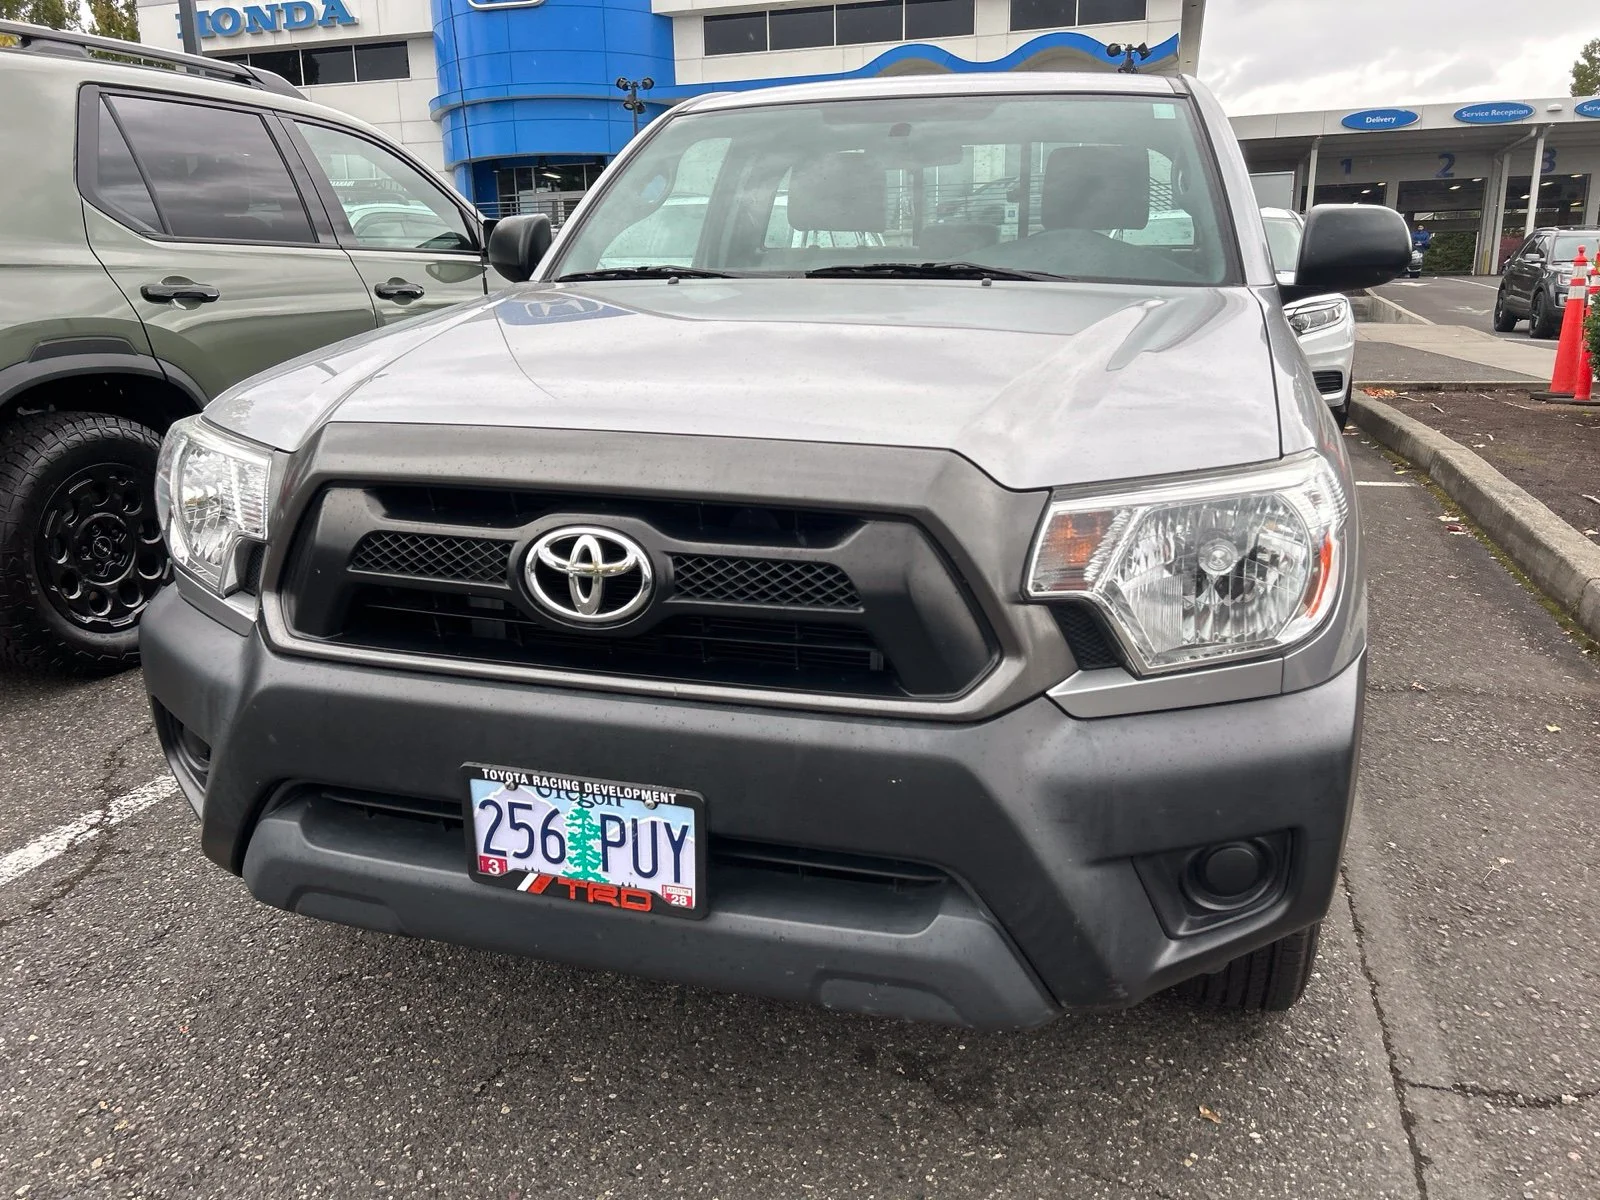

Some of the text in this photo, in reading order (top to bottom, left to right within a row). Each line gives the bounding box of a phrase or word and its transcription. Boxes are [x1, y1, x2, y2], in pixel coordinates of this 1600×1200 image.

[1365, 115, 1397, 125] Delivery
[1461, 107, 1529, 118] Service Reception
[1340, 158, 1353, 175] 1
[1435, 153, 1456, 178] 2
[481, 768, 677, 805] TOYOTA RACING DEVELOPMENT
[478, 798, 690, 884] 256 PUY
[488, 858, 501, 875] 3
[557, 876, 653, 913] TRD
[670, 894, 688, 906] 28
